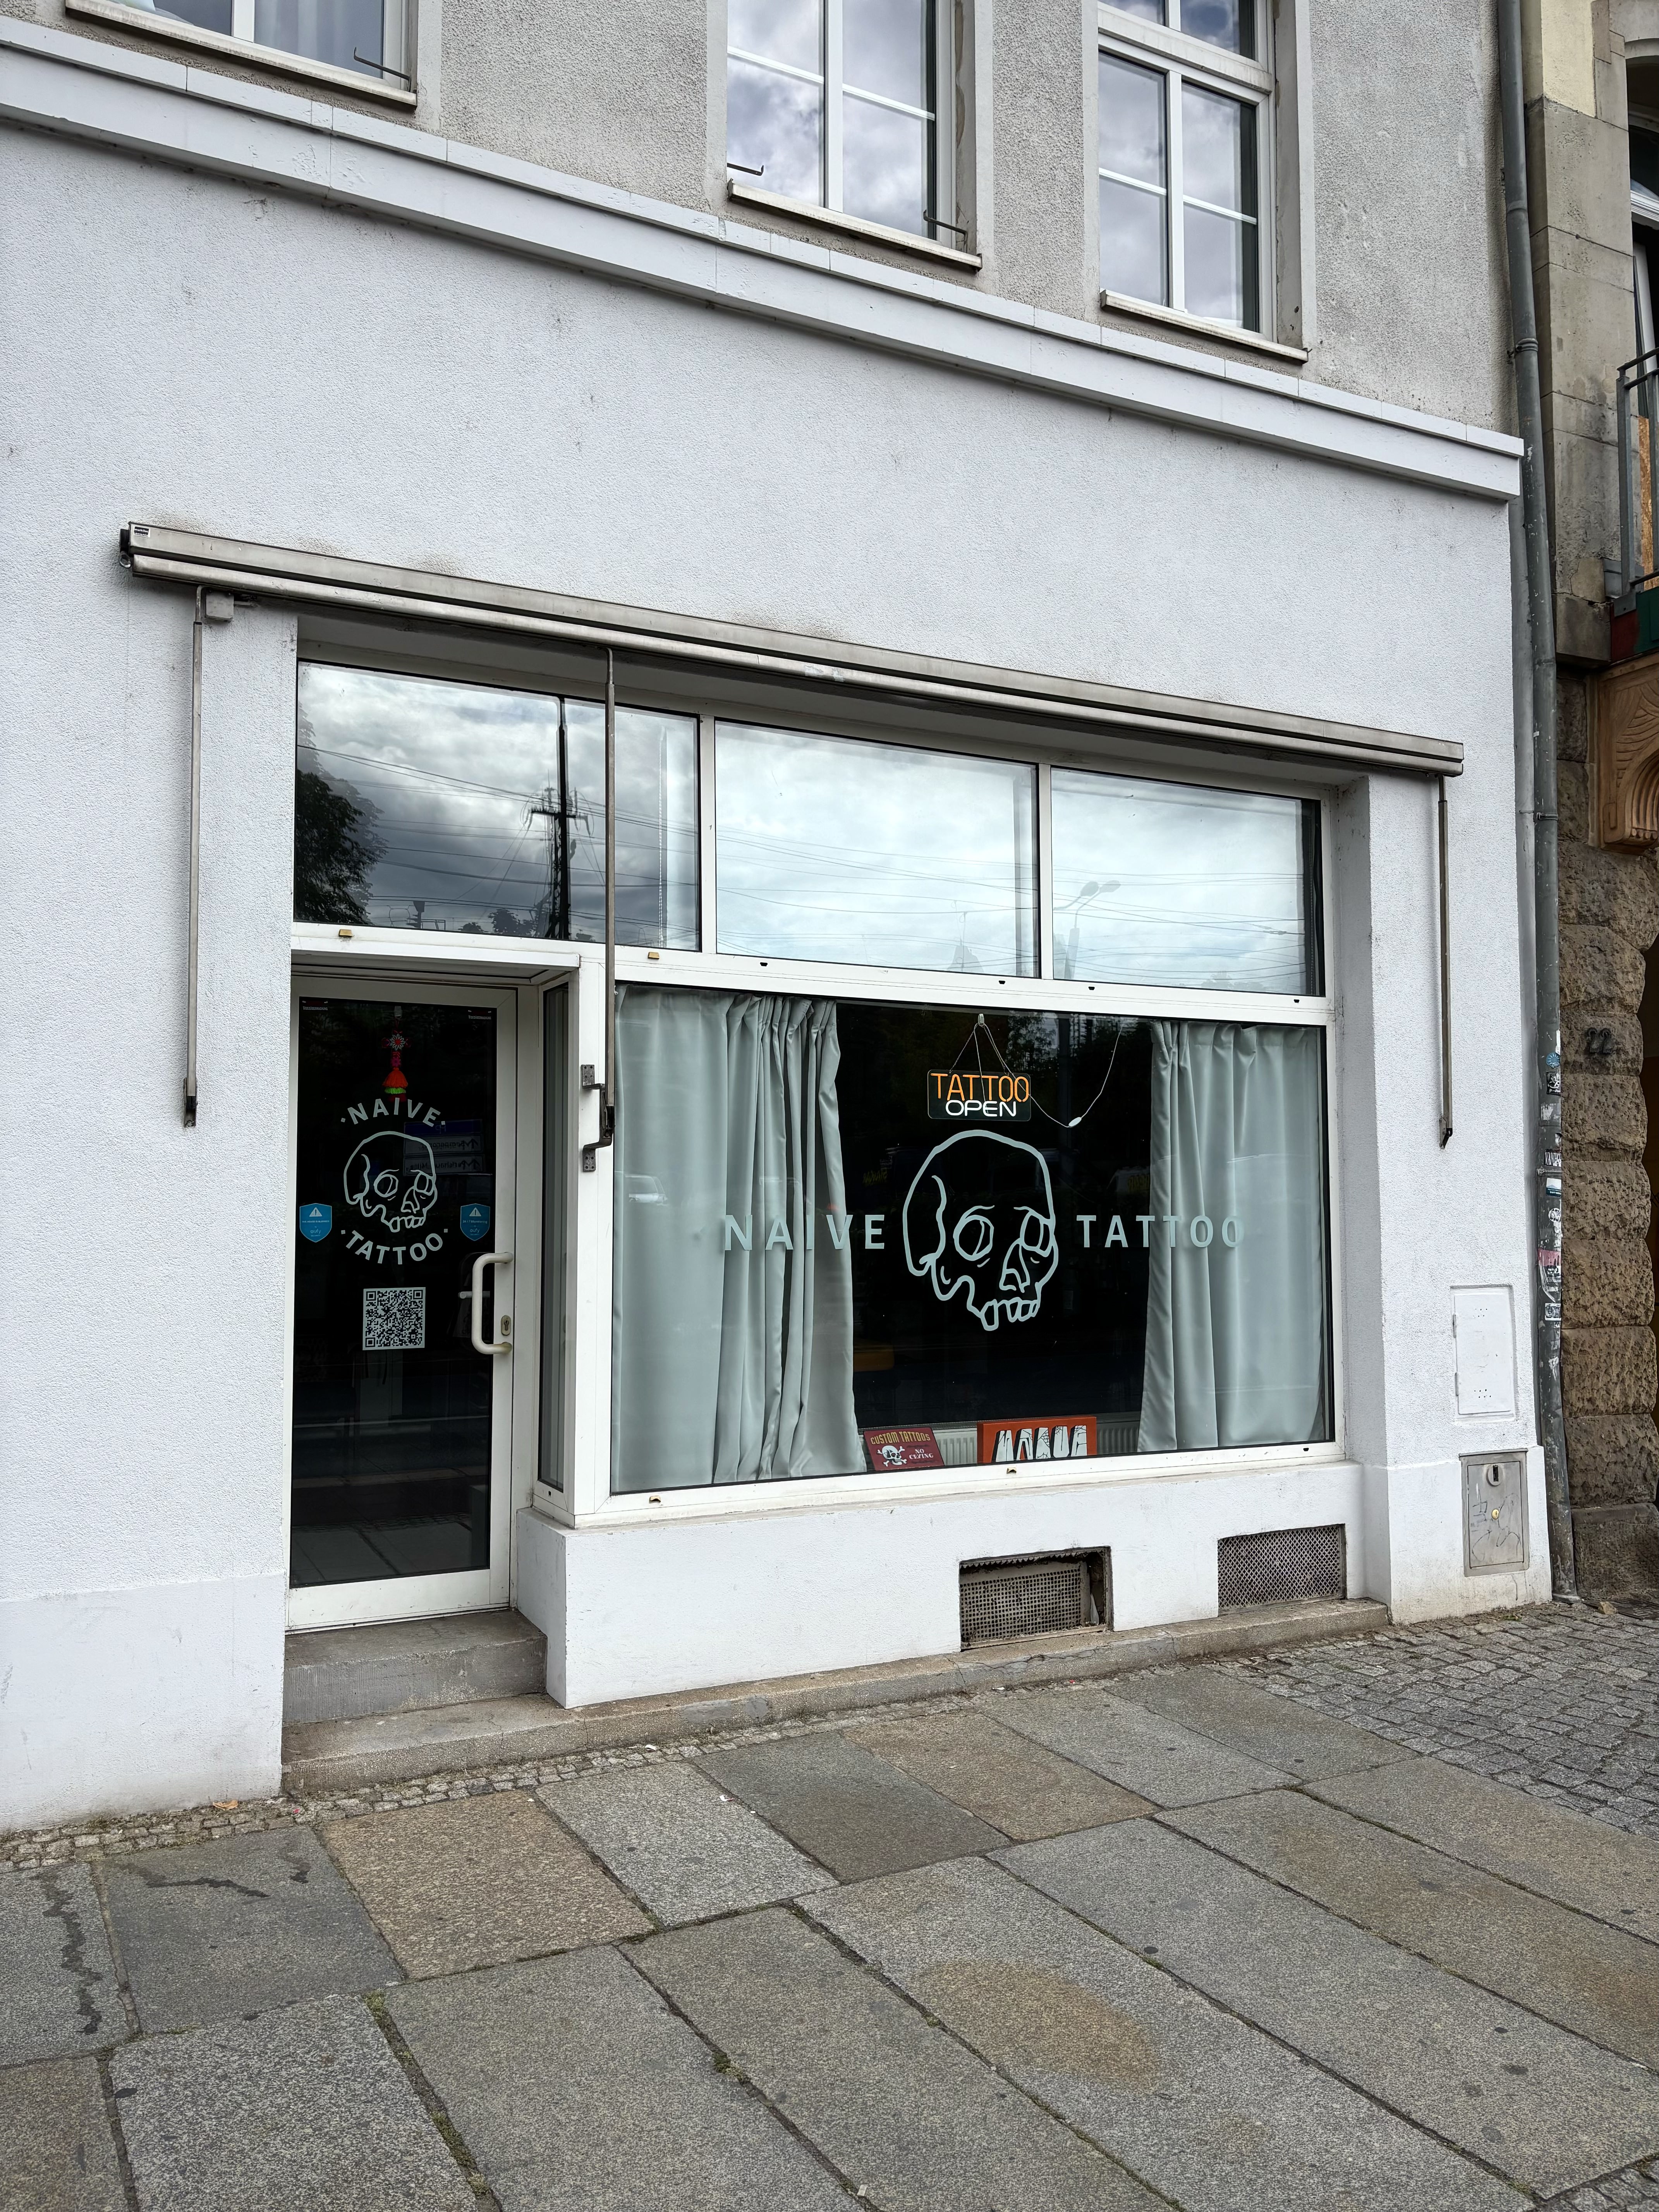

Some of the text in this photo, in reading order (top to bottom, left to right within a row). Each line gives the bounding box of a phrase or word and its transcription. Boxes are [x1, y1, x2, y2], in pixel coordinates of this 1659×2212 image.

[931, 1073, 1029, 1103] TATTOO
[348, 1098, 441, 1126] NAIVE
[946, 1100, 1017, 1117] OPEN
[725, 1214, 1244, 1250] NAIVE TATTOO
[345, 1231, 443, 1265] TATTOO
[870, 1431, 931, 1444] CUSTOM TATTOOS
